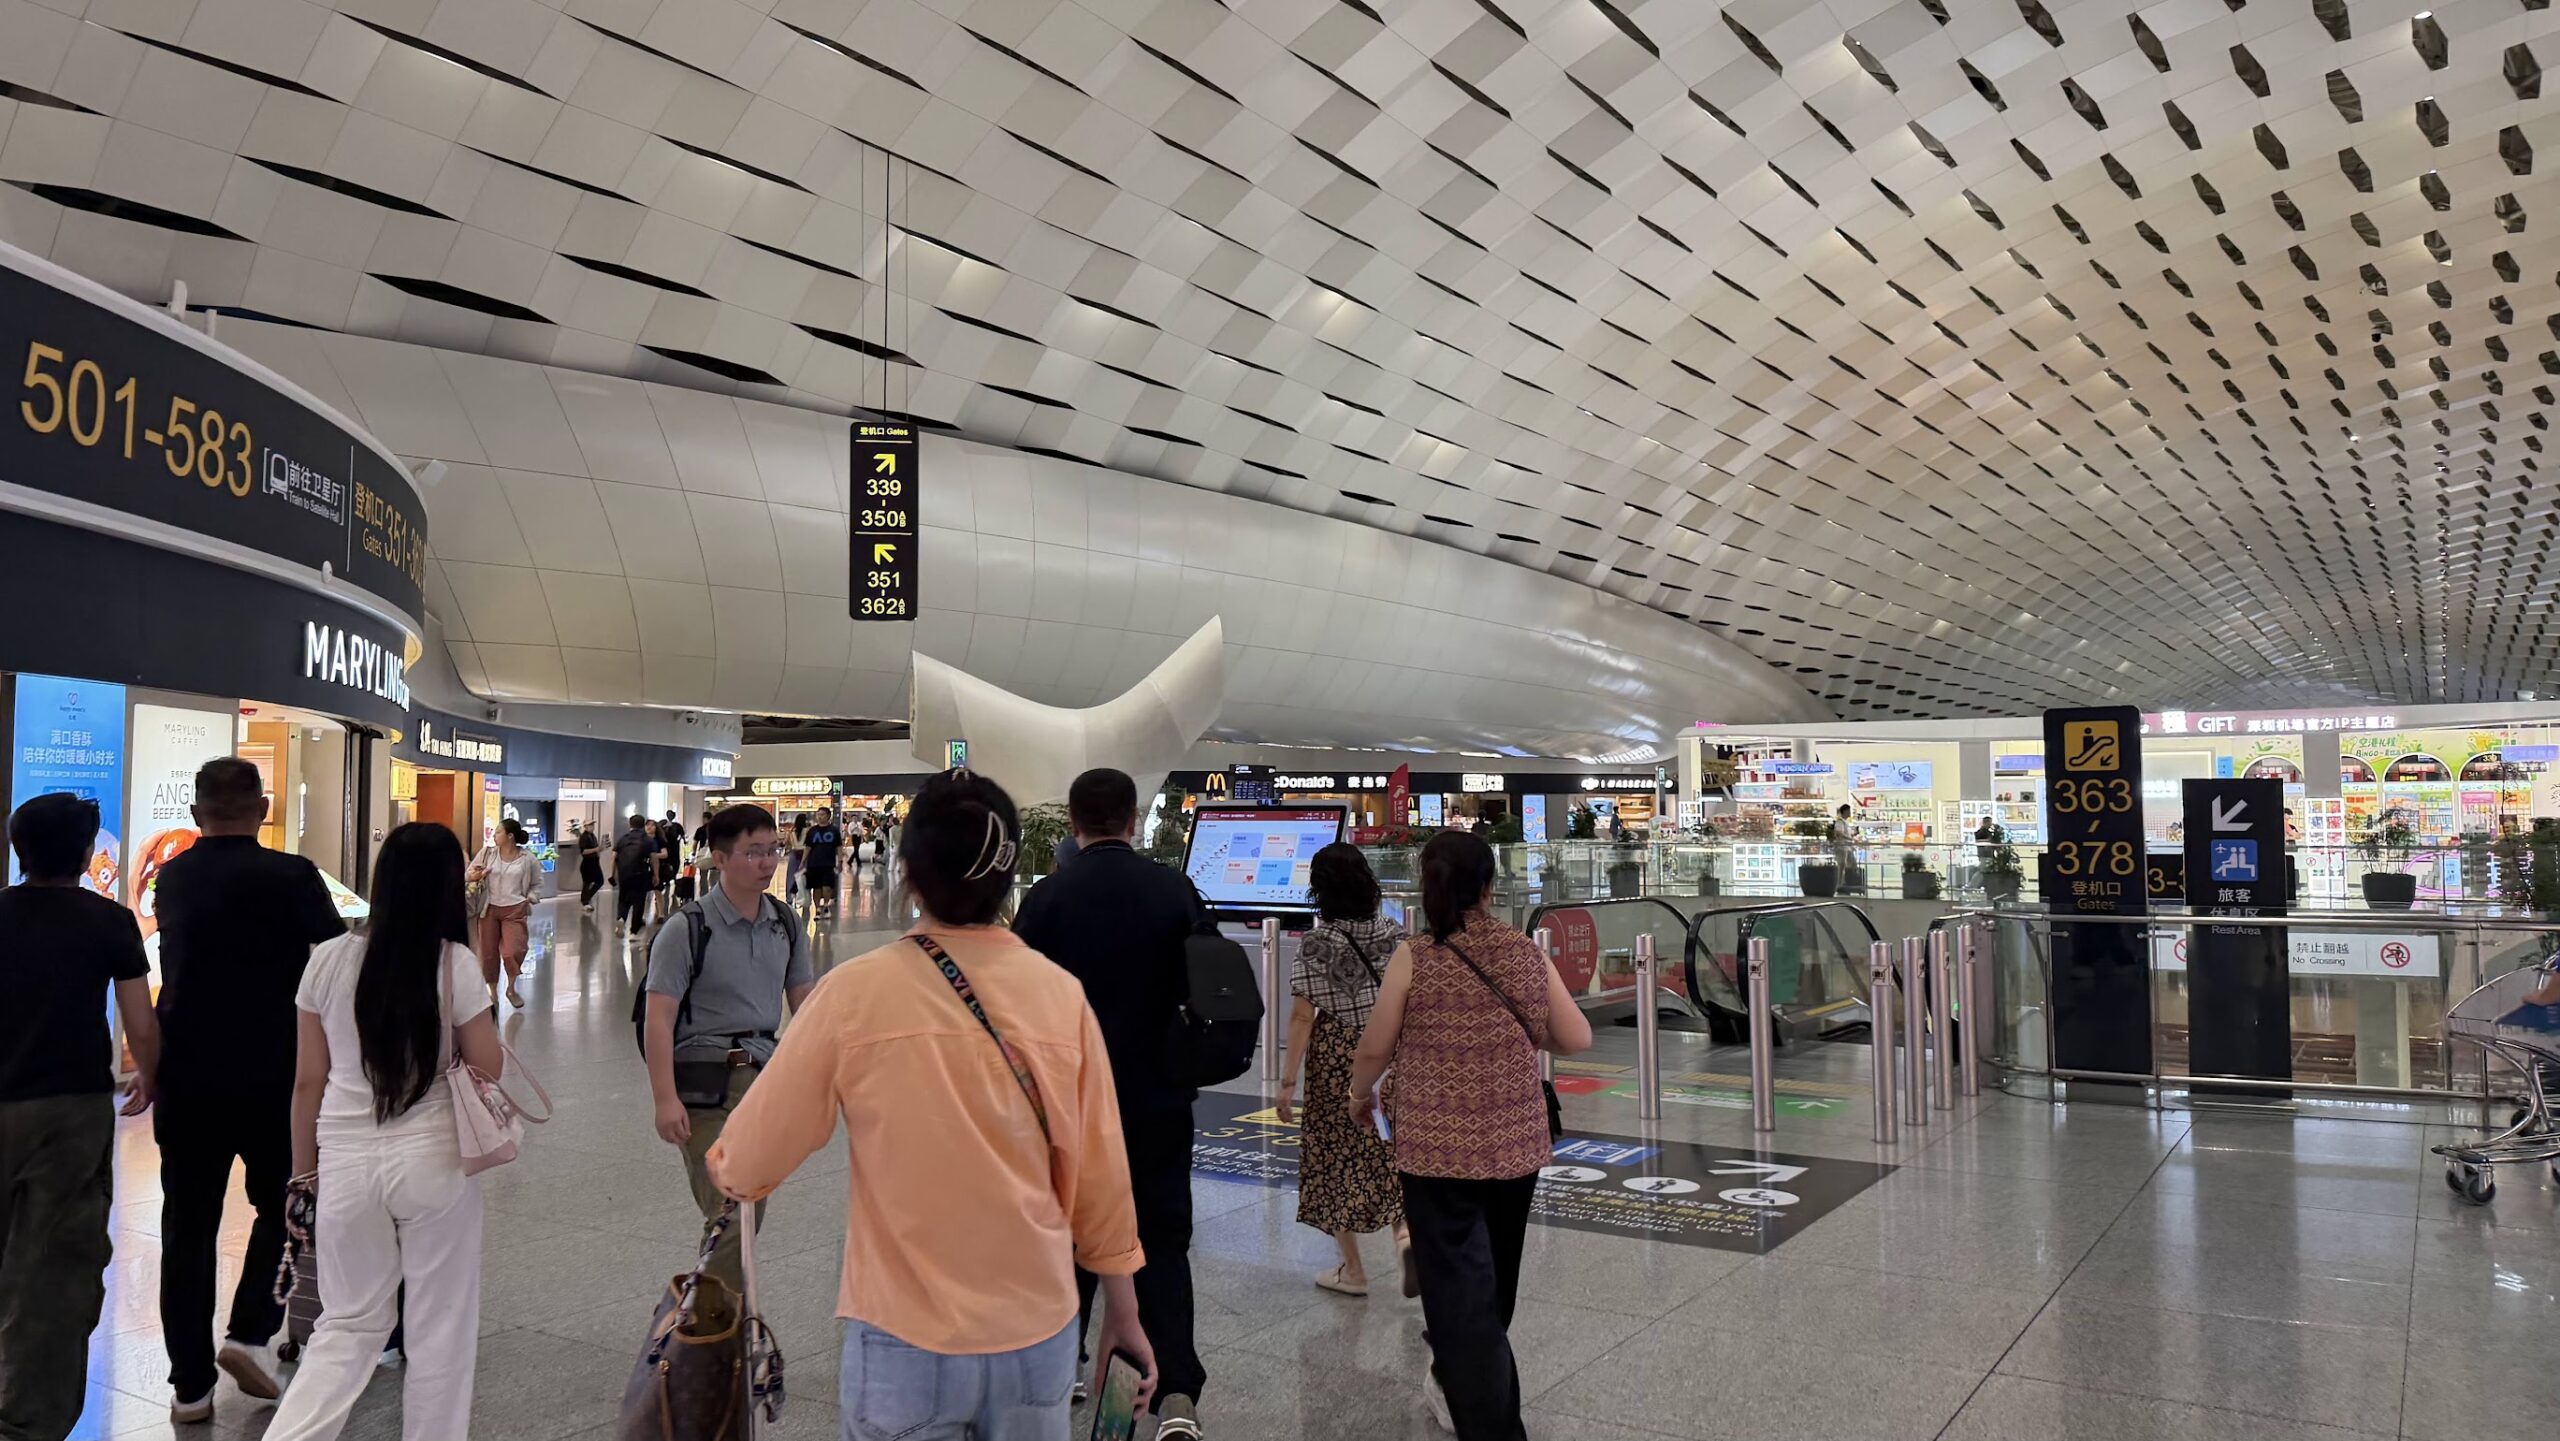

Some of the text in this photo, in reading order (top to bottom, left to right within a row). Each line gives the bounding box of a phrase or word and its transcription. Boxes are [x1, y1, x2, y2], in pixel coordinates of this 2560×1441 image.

[21, 341, 252, 497] 501-583
[860, 427, 908, 436] 登机口 Gates
[289, 460, 341, 506] 前往卫星厅
[866, 479, 901, 496] 339
[354, 482, 384, 529] 登机口
[861, 510, 898, 527] 350
[362, 528, 382, 557] Gates
[867, 571, 900, 588] 351
[861, 598, 898, 615] 362
[306, 620, 404, 705] MARYLING
[164, 724, 206, 737] MARYLING
[2198, 716, 2237, 732] GIFT
[1274, 776, 1335, 788] cDonald's
[2054, 778, 2133, 813] 363
[153, 807, 174, 820] BEEF
[2056, 841, 2135, 876] 378
[2071, 881, 2121, 896] 登机口
[2218, 887, 2252, 903] 旅客
[2077, 898, 2115, 910] Gates
[2212, 925, 2261, 936] Rest Area
[2297, 942, 2350, 955] 禁止翻越
[2293, 956, 2346, 966] No Crossing
